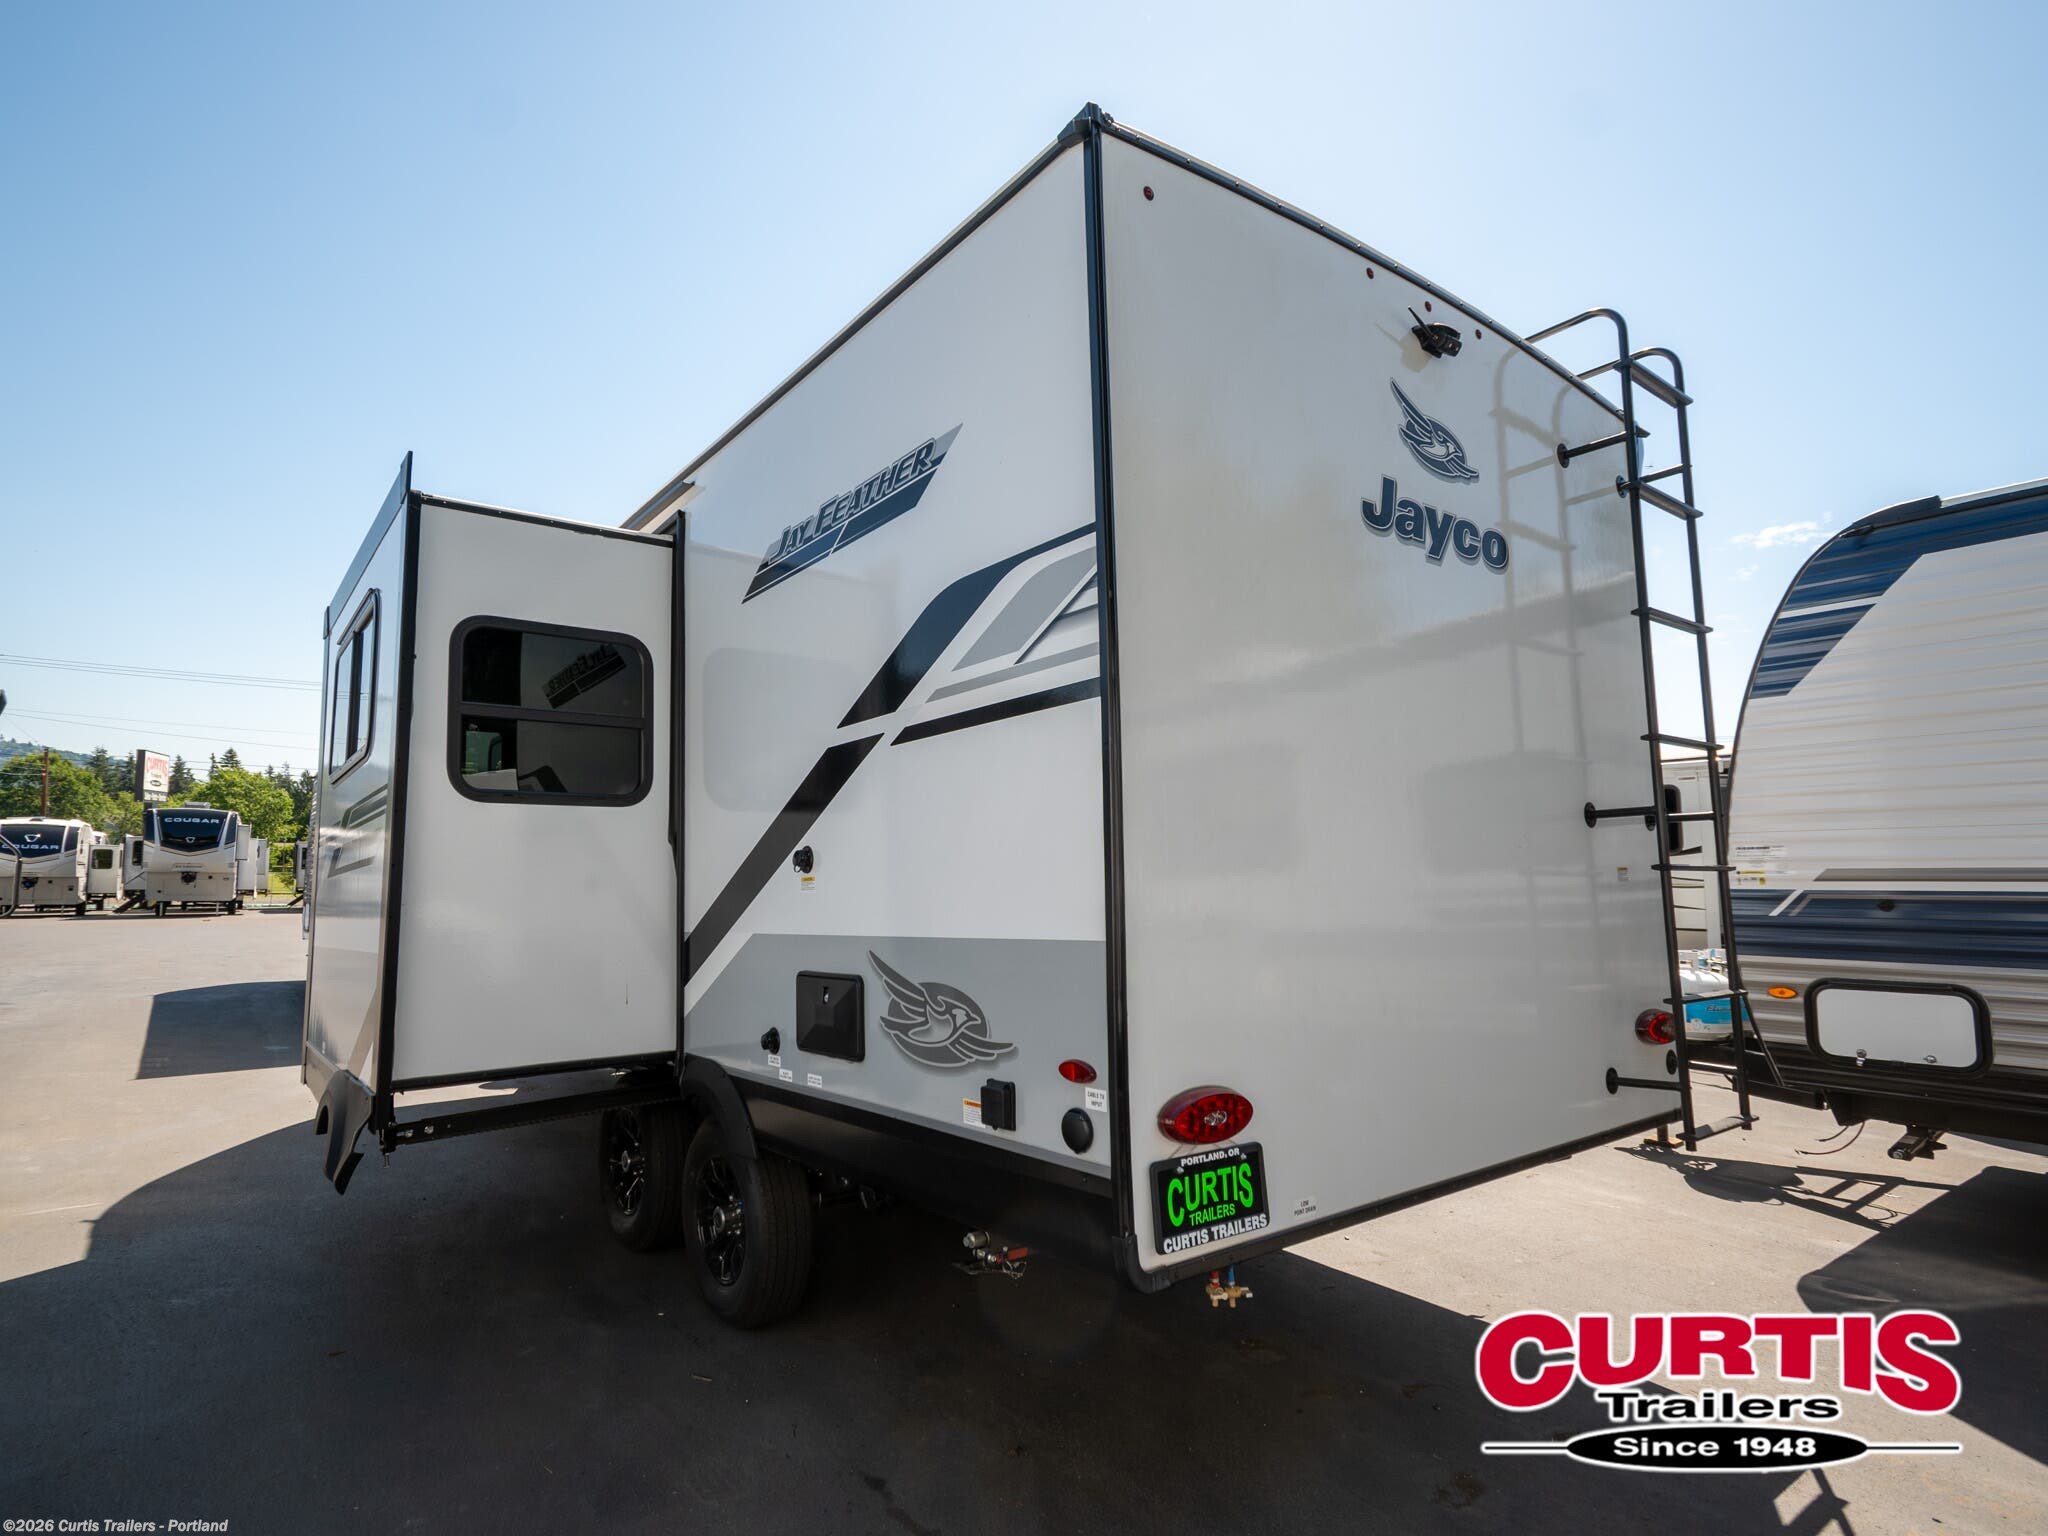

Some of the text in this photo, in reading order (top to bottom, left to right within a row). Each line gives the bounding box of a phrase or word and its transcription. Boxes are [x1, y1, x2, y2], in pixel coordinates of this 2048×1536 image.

[768, 437, 936, 565] JAY FEATHER
[1361, 474, 1509, 571] Jayco
[1181, 1147, 1240, 1167] PORTLAND, OR
[1167, 1162, 1254, 1227] CURTIS
[1189, 1203, 1236, 1226] TRAILERS
[1163, 1214, 1267, 1254] CURTIS TRAILERS
